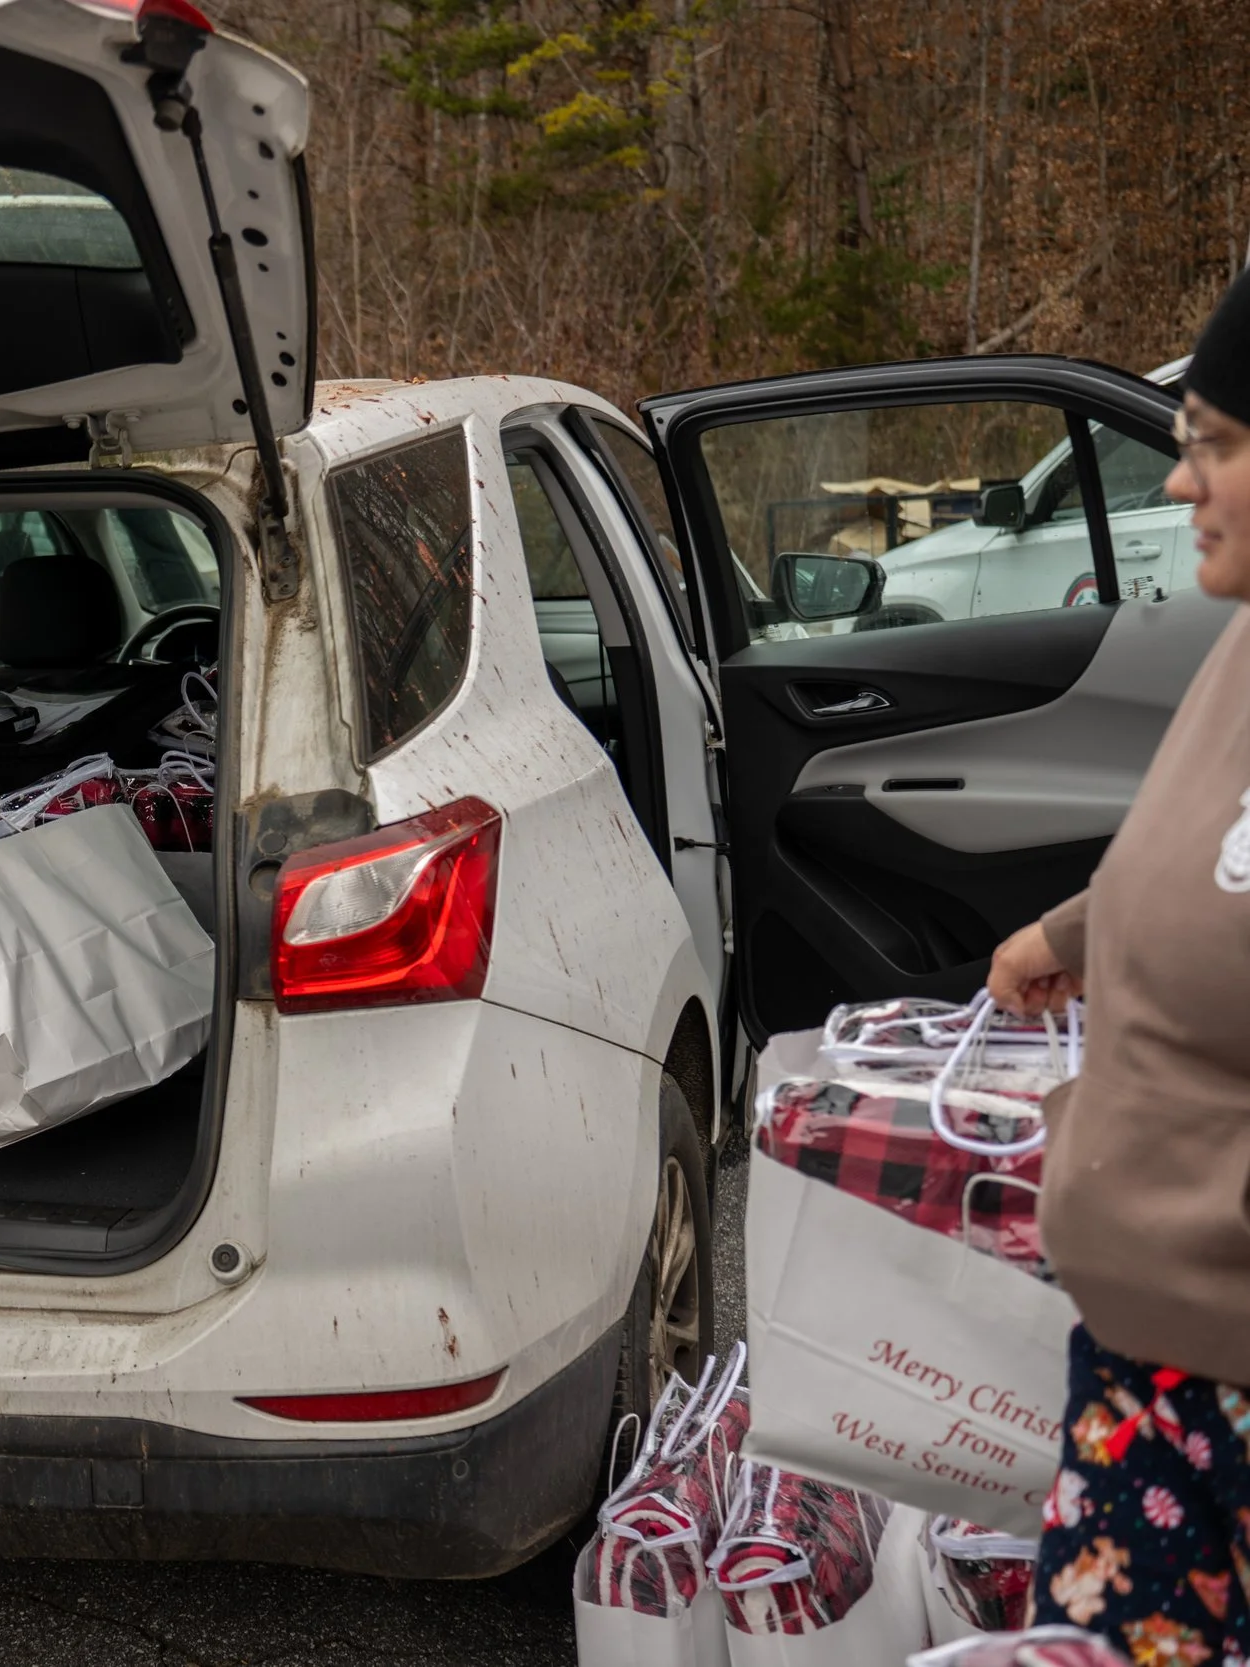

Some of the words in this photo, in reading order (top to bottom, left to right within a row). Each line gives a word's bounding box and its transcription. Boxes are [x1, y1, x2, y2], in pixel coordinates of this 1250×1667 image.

[868, 1339, 963, 1402] Merry
[832, 1411, 907, 1461] West
[912, 1451, 1018, 1495] Senior
[932, 1418, 1017, 1468] from
